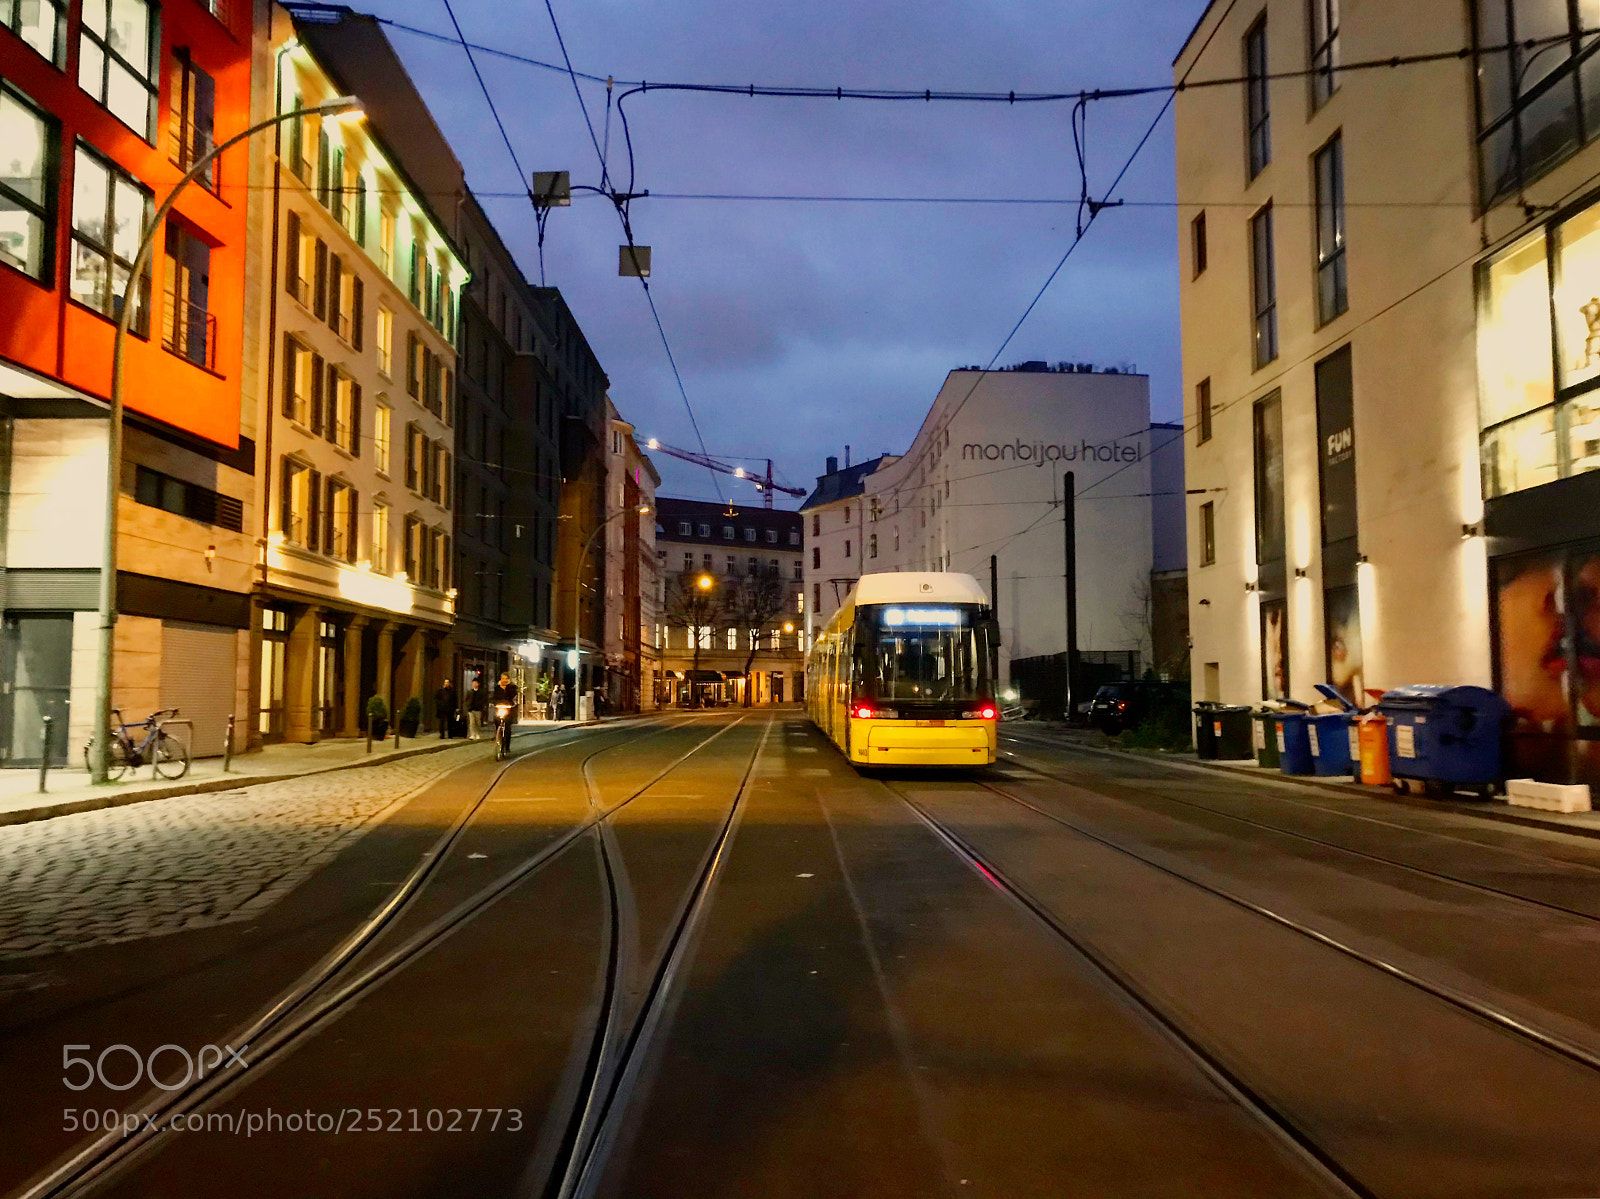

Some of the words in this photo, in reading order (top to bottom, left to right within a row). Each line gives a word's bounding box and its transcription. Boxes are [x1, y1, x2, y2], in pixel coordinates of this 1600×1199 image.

[962, 438, 1077, 467] monbijou
[1081, 439, 1142, 462] hotel
[1327, 427, 1352, 456] FUN
